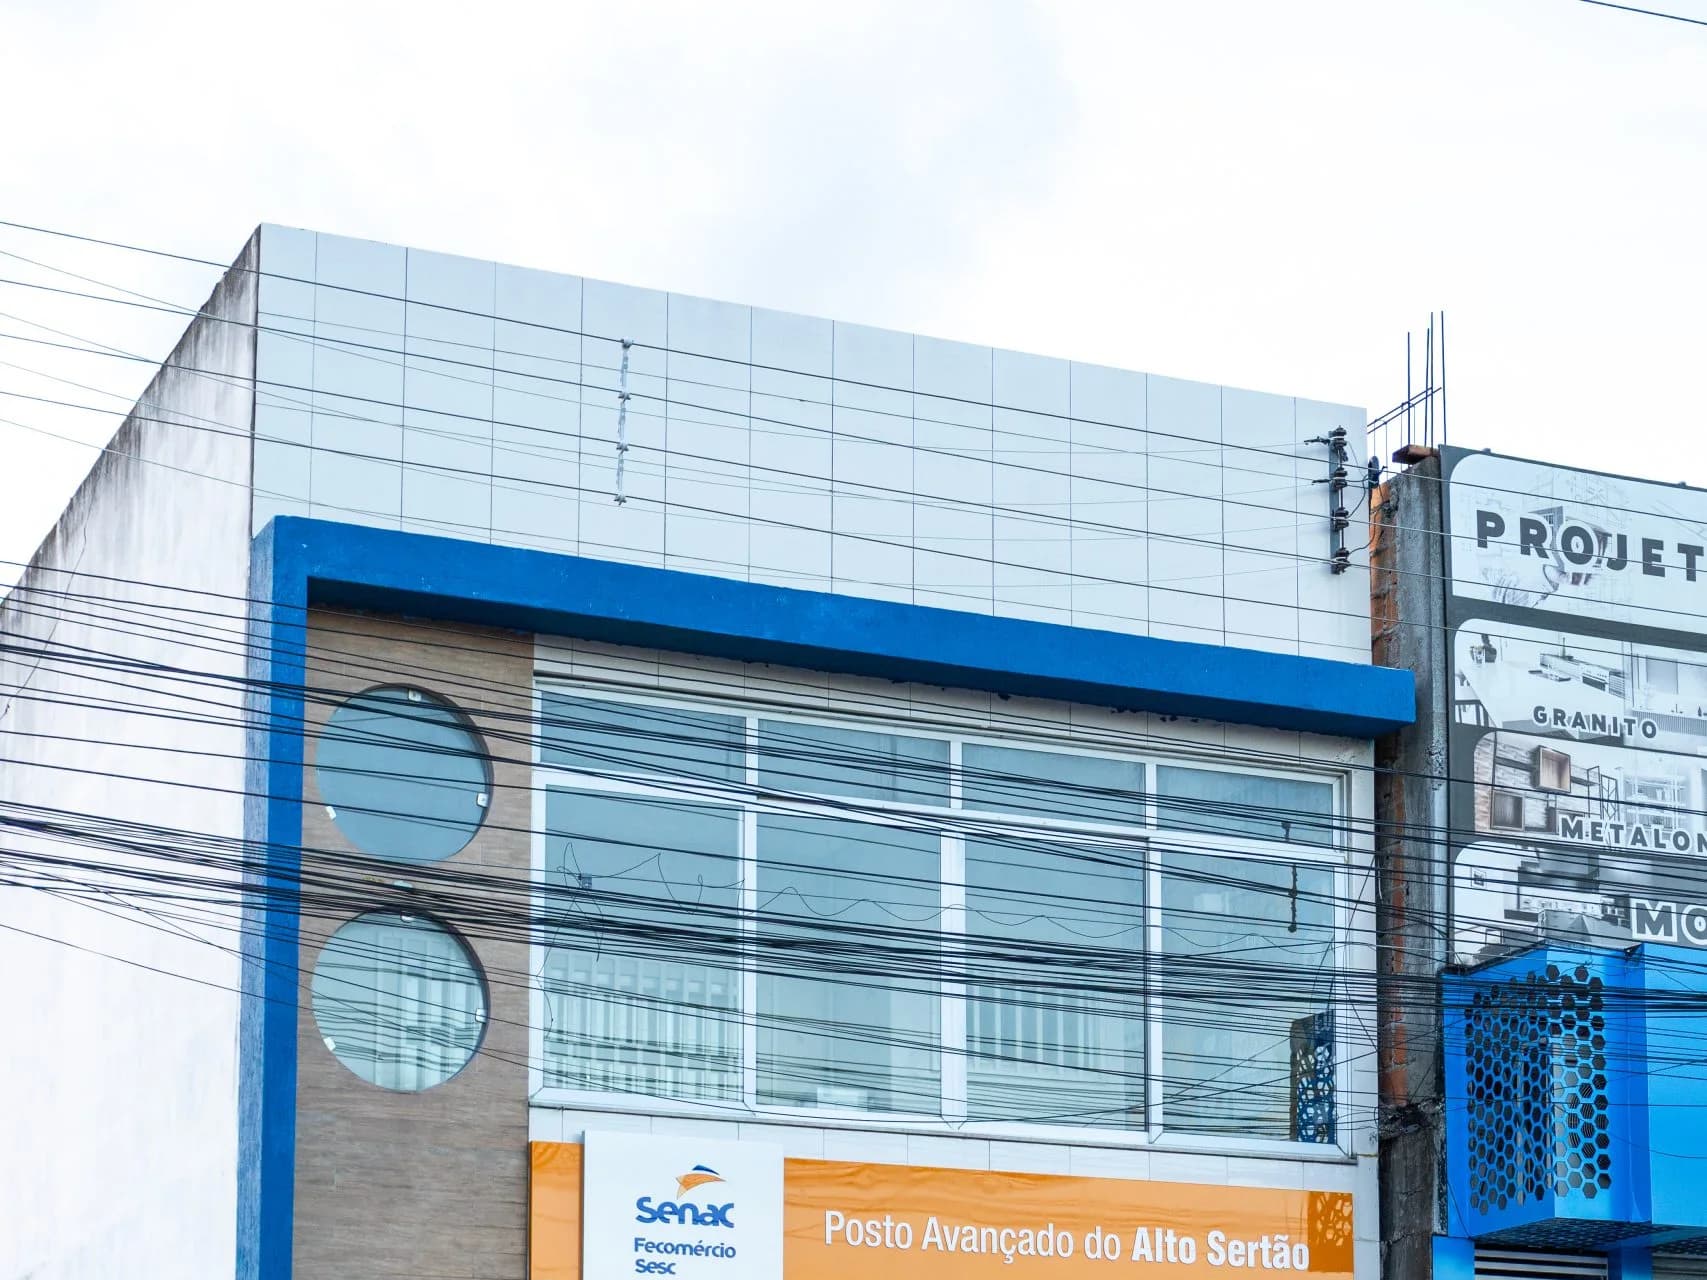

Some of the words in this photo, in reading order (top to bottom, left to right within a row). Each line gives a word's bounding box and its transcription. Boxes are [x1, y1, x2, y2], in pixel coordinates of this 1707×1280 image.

[1476, 509, 1704, 582] PROJET
[1533, 705, 1658, 739] GRANITO
[635, 1196, 735, 1229] Senac
[633, 1237, 737, 1259] Fecomércio
[824, 1210, 913, 1250] Posto
[921, 1215, 1074, 1264] Avançado
[1084, 1225, 1121, 1261] do
[1131, 1227, 1197, 1265] Alto
[1207, 1229, 1310, 1271] Sertão
[634, 1258, 677, 1275] Sesc
